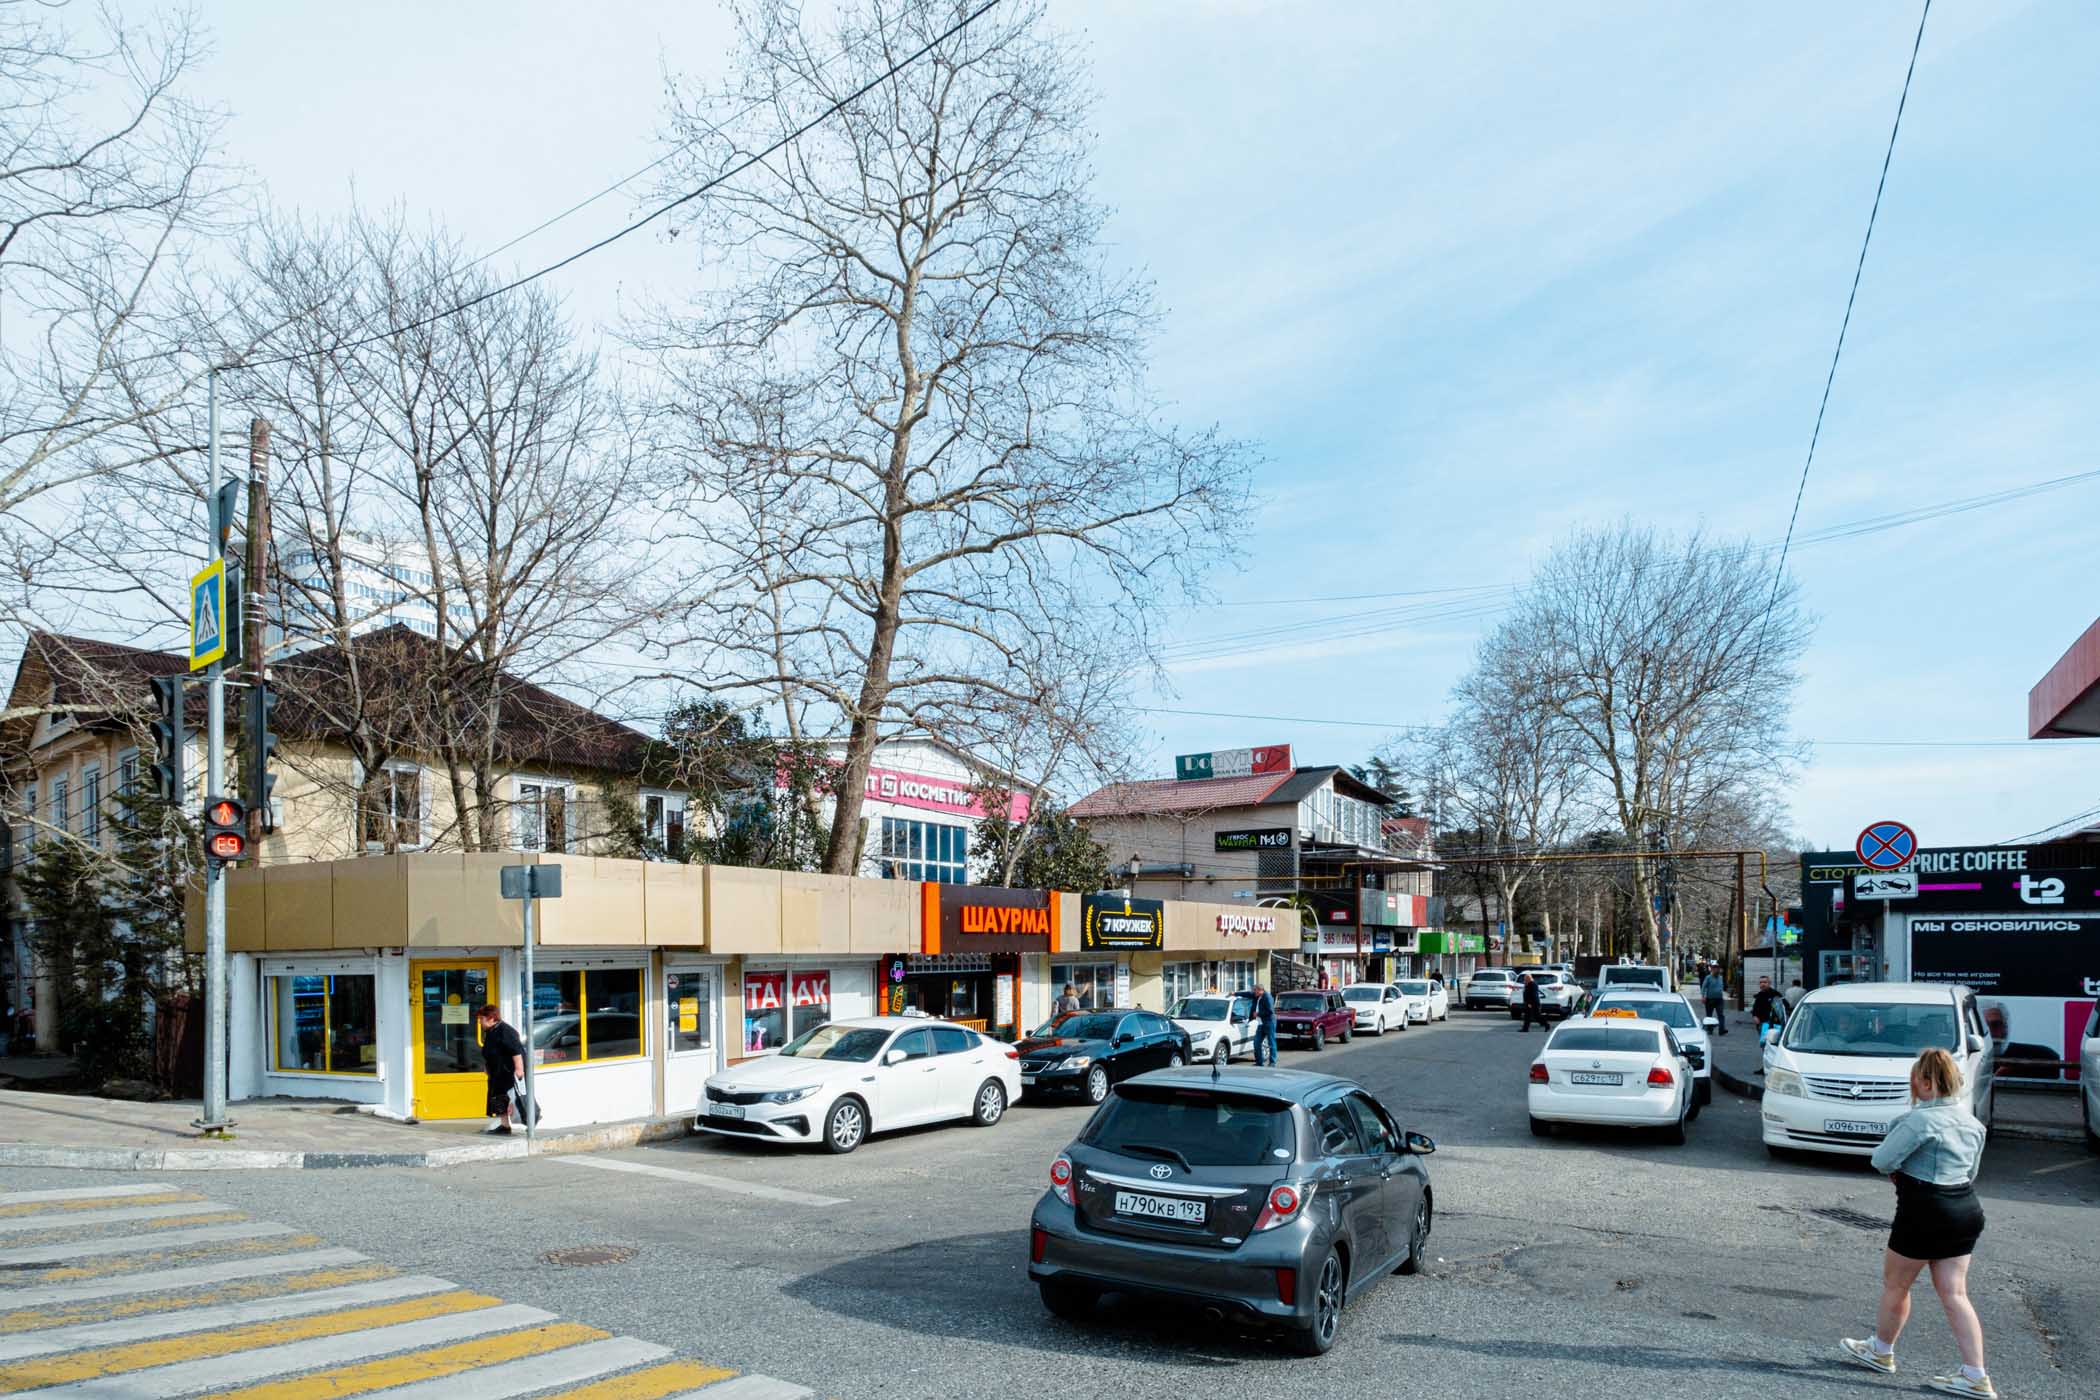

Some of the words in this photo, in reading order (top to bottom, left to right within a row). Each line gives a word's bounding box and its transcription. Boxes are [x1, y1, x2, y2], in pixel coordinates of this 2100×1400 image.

[1909, 852, 1960, 873] PRICE
[1963, 850, 2028, 871] COFFEE
[2020, 875, 2066, 905] t2
[962, 905, 1049, 934] ШАУРМА
[1103, 918, 1112, 932] 7
[1112, 918, 1153, 933] КРУЖЕК
[1914, 922, 1945, 932] МЫ
[1951, 921, 2081, 932] ОБНОВИЛИСЬ
[746, 979, 828, 1013] ТААК
[1120, 1195, 1176, 1216] Н790КВ
[1179, 1202, 1202, 1216] 193
